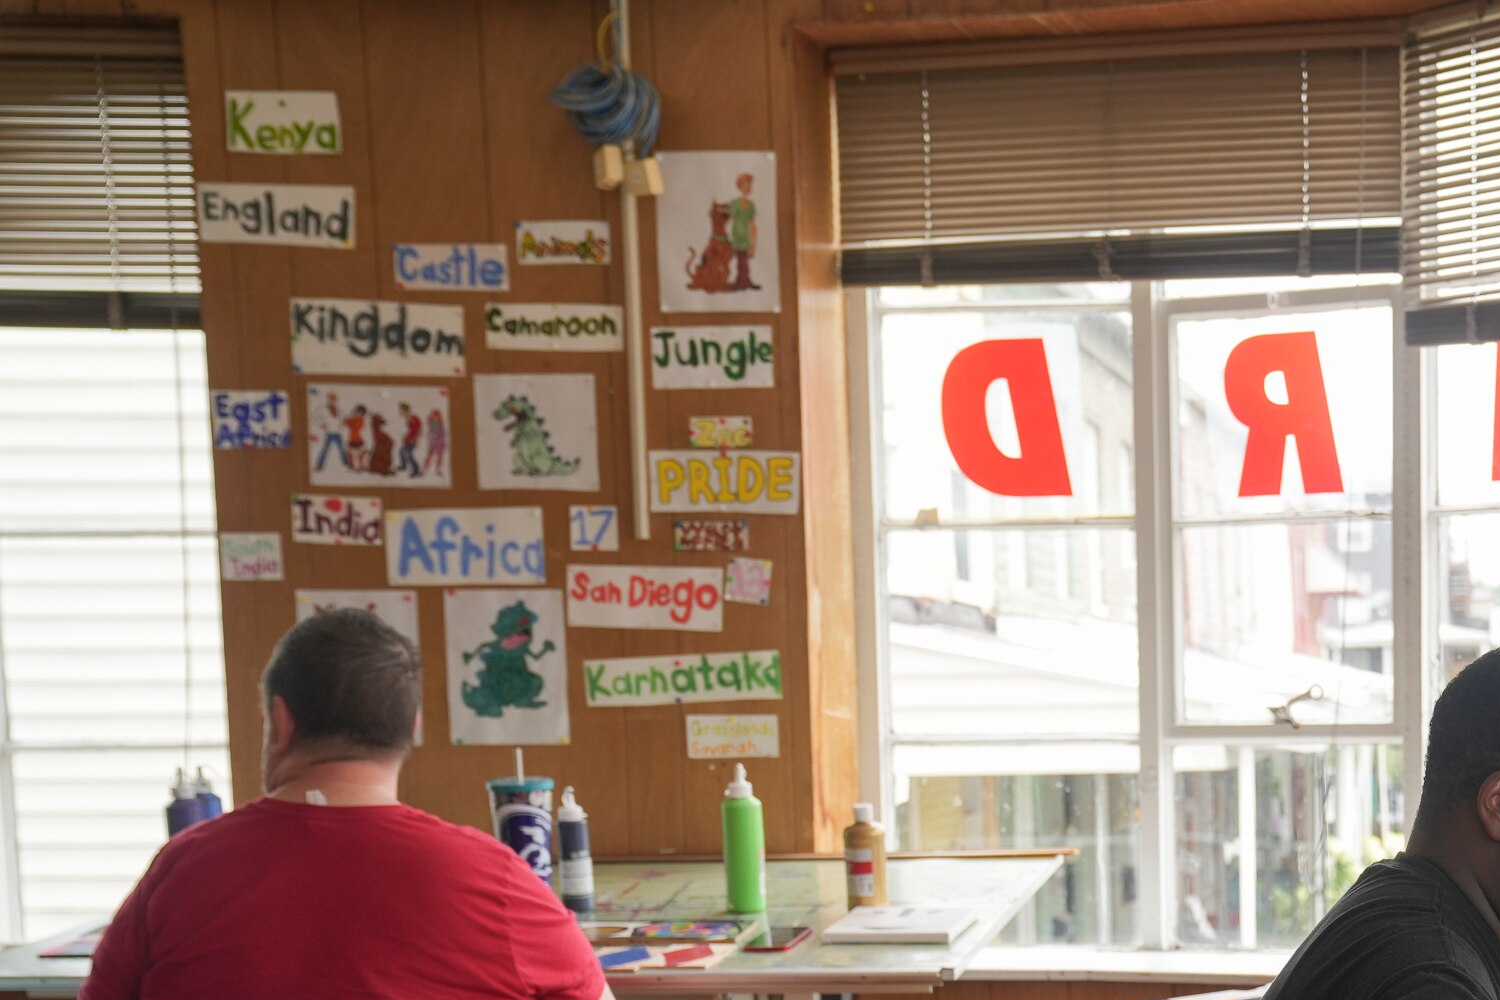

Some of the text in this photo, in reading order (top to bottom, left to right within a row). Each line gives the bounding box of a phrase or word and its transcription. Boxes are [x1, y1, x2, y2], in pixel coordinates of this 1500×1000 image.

[228, 98, 337, 152] Kenya
[202, 192, 350, 241] England
[394, 246, 505, 286] Castle
[292, 302, 465, 358] Kingdom
[652, 331, 773, 381] Jungle
[214, 392, 286, 424] East
[656, 456, 794, 505] PRIDE
[295, 499, 382, 544] India
[570, 509, 614, 547] 17
[397, 515, 546, 579] Africa
[571, 572, 719, 624] San Diego
[584, 653, 783, 702] Karnataka
